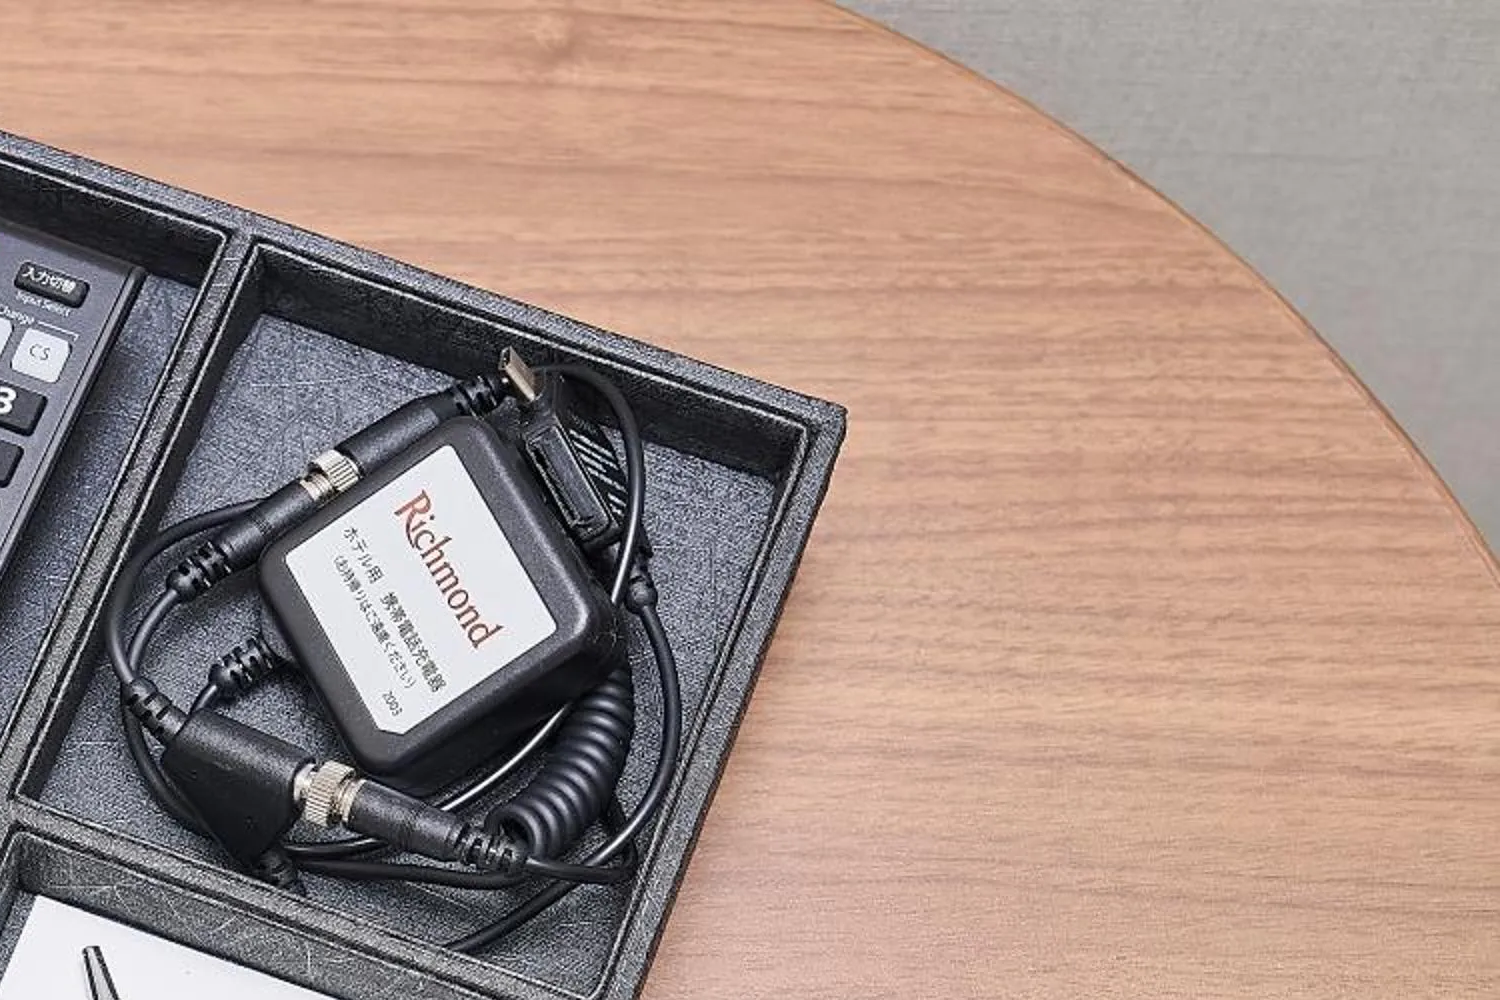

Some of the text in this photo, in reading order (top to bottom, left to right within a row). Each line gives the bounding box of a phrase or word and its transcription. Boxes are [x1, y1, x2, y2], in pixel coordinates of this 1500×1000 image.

[29, 343, 51, 362] CS
[344, 526, 384, 584] ホテル用
[394, 489, 506, 649] Richmond
